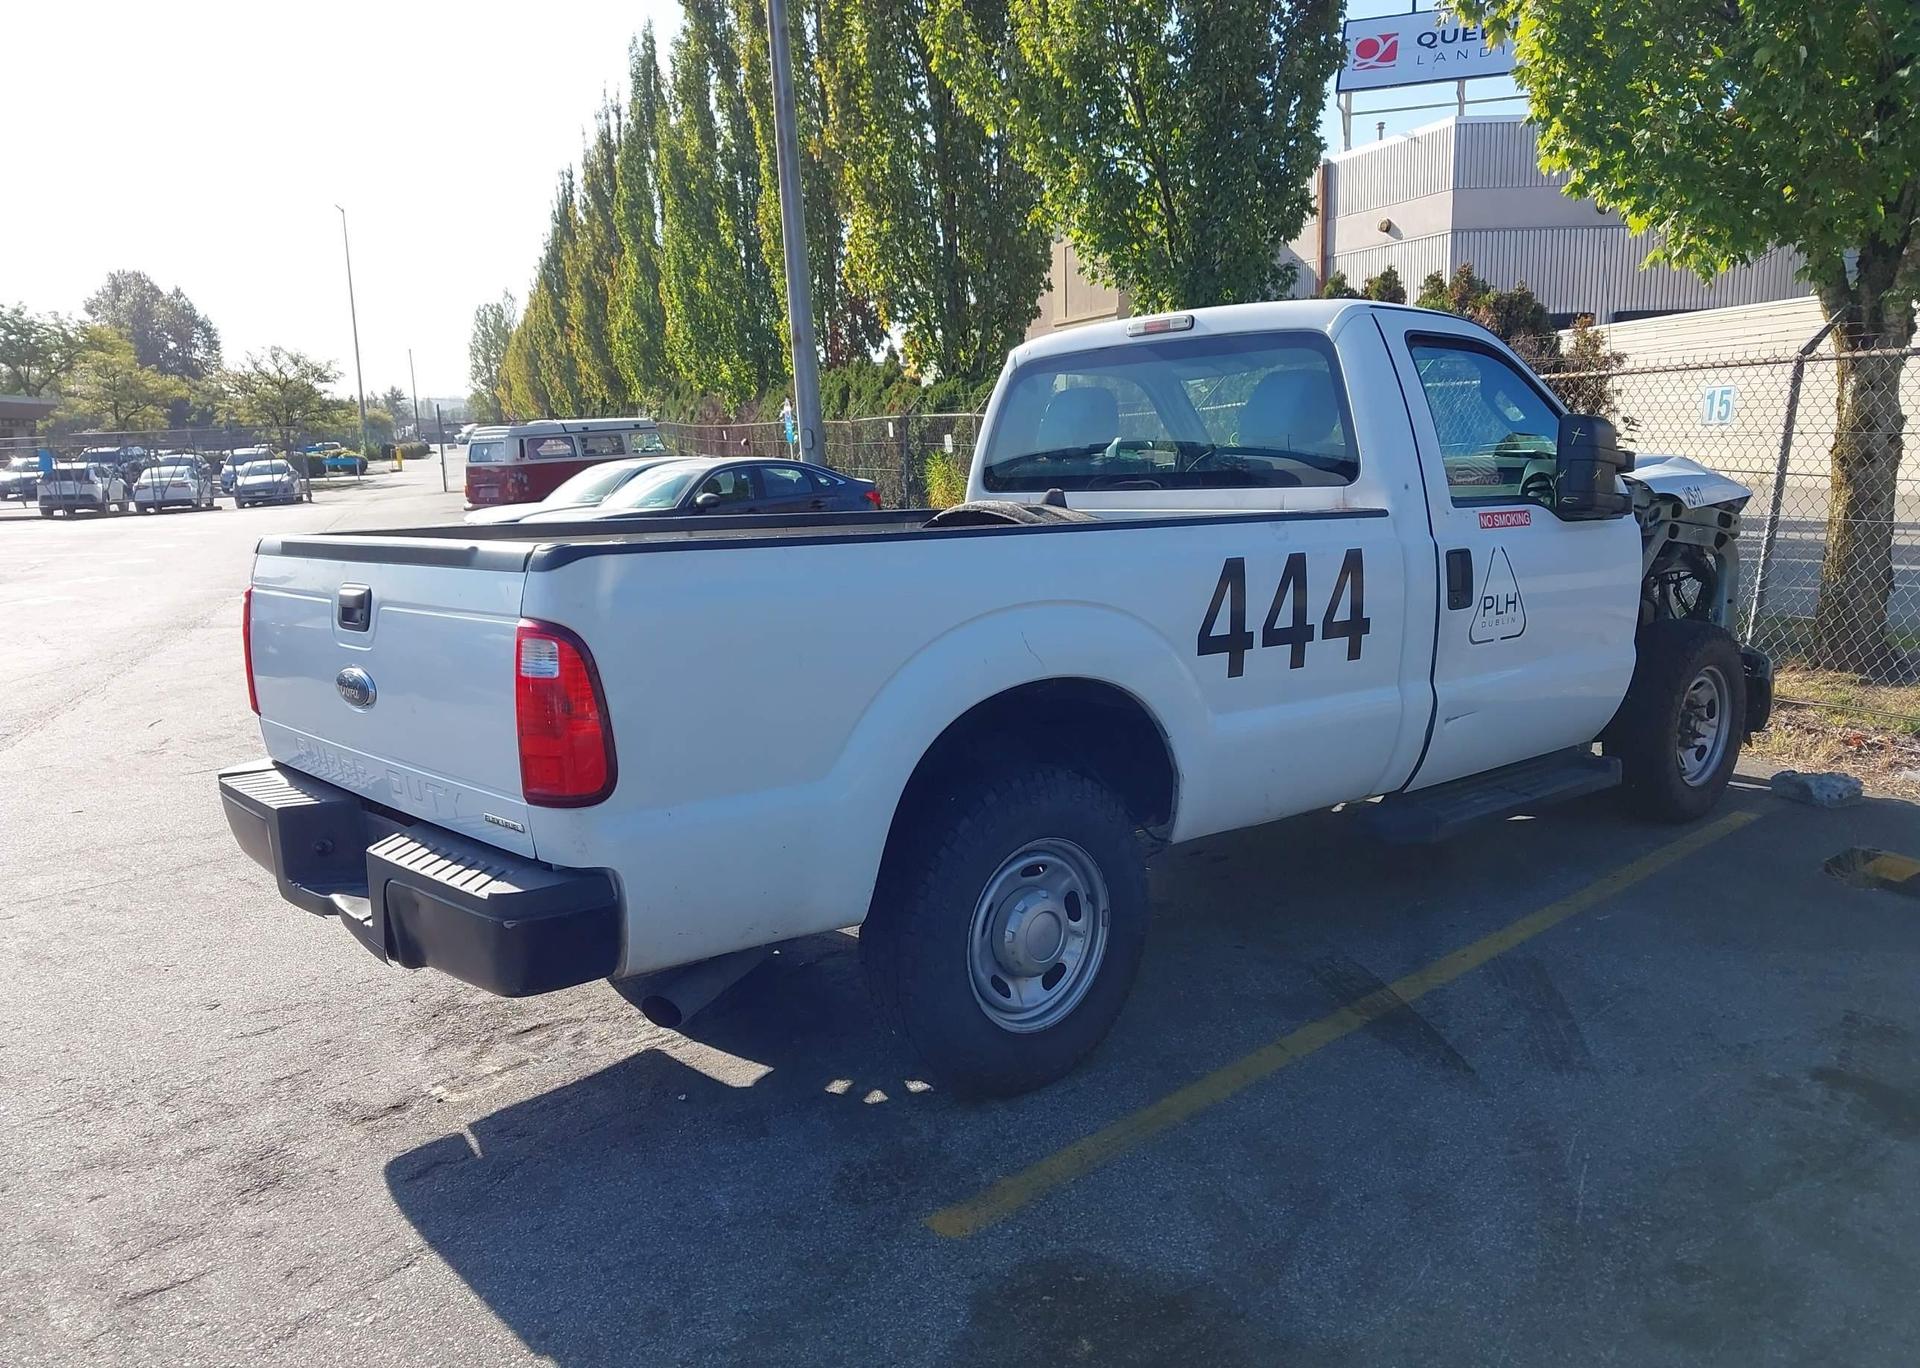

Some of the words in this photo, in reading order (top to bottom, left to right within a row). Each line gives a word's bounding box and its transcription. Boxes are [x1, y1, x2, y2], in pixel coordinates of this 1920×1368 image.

[1417, 45, 1505, 65] LANDI
[1706, 389, 1732, 421] 15
[1682, 485, 1705, 506] VS-11
[1479, 514, 1493, 528] NO
[1493, 512, 1530, 526] SMOKING
[1197, 548, 1371, 679] 444
[1482, 592, 1517, 618] PLH
[1481, 617, 1516, 629] DUBLIN
[385, 768, 462, 818] DUTY
